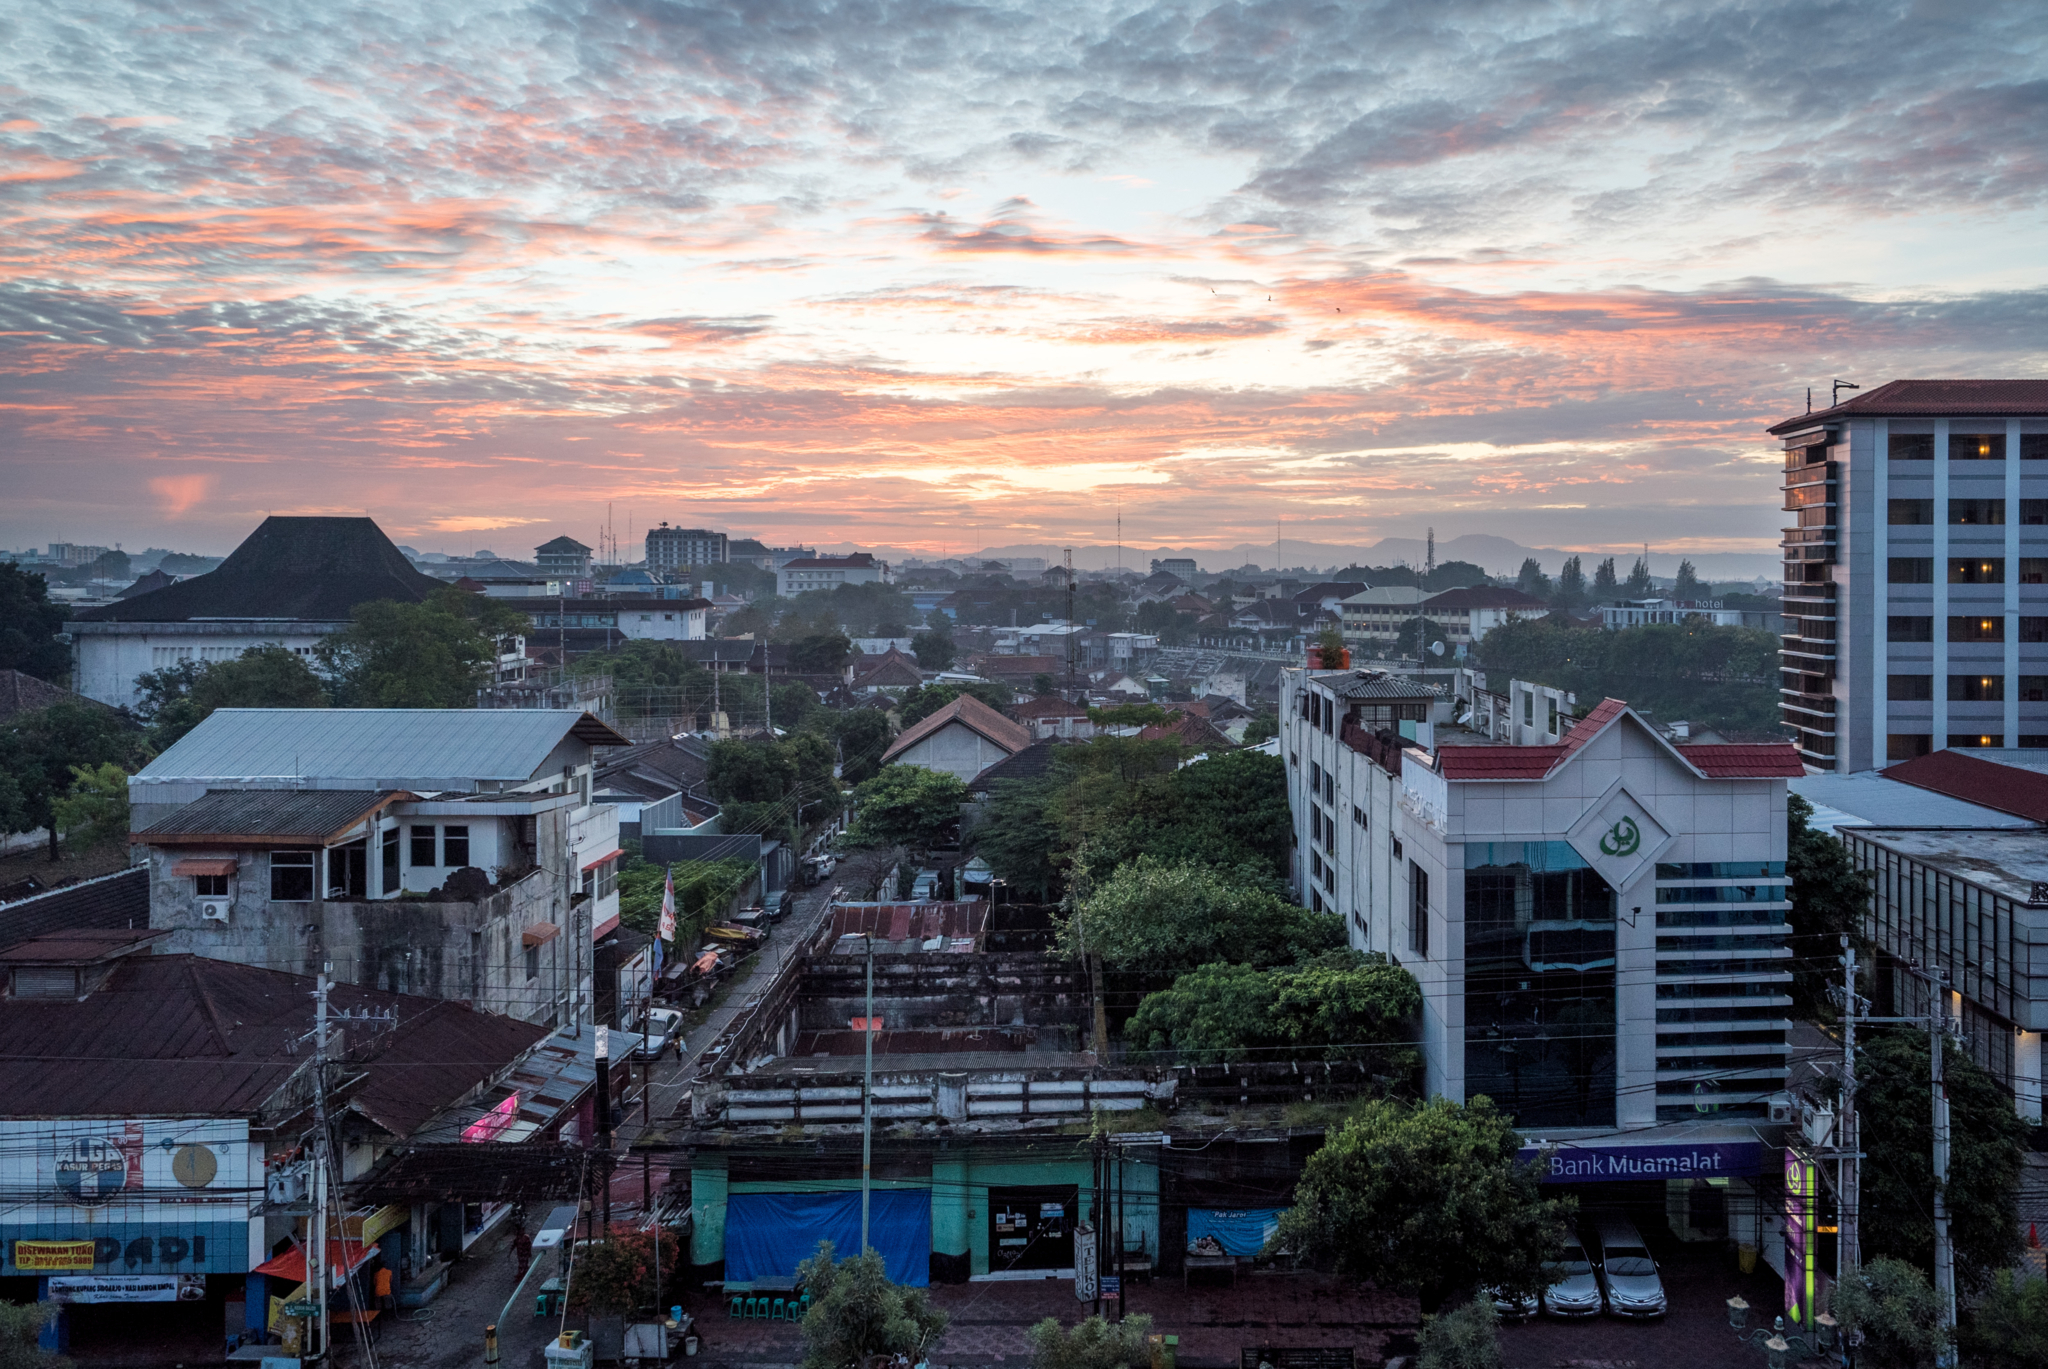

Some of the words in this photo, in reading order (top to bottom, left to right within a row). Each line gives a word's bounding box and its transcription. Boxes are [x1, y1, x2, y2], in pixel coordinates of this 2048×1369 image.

[1695, 599, 1724, 609] hotel
[57, 1139, 122, 1163] ALGA
[57, 1162, 89, 1171] KASUR
[91, 1162, 123, 1172] PEGAS
[1550, 1155, 1604, 1176] Bank
[1608, 1152, 1722, 1174] Muamalat
[18, 1246, 69, 1255] DISEWAKAN
[71, 1246, 93, 1255] TOKO
[1084, 1246, 1096, 1300] TELKOM
